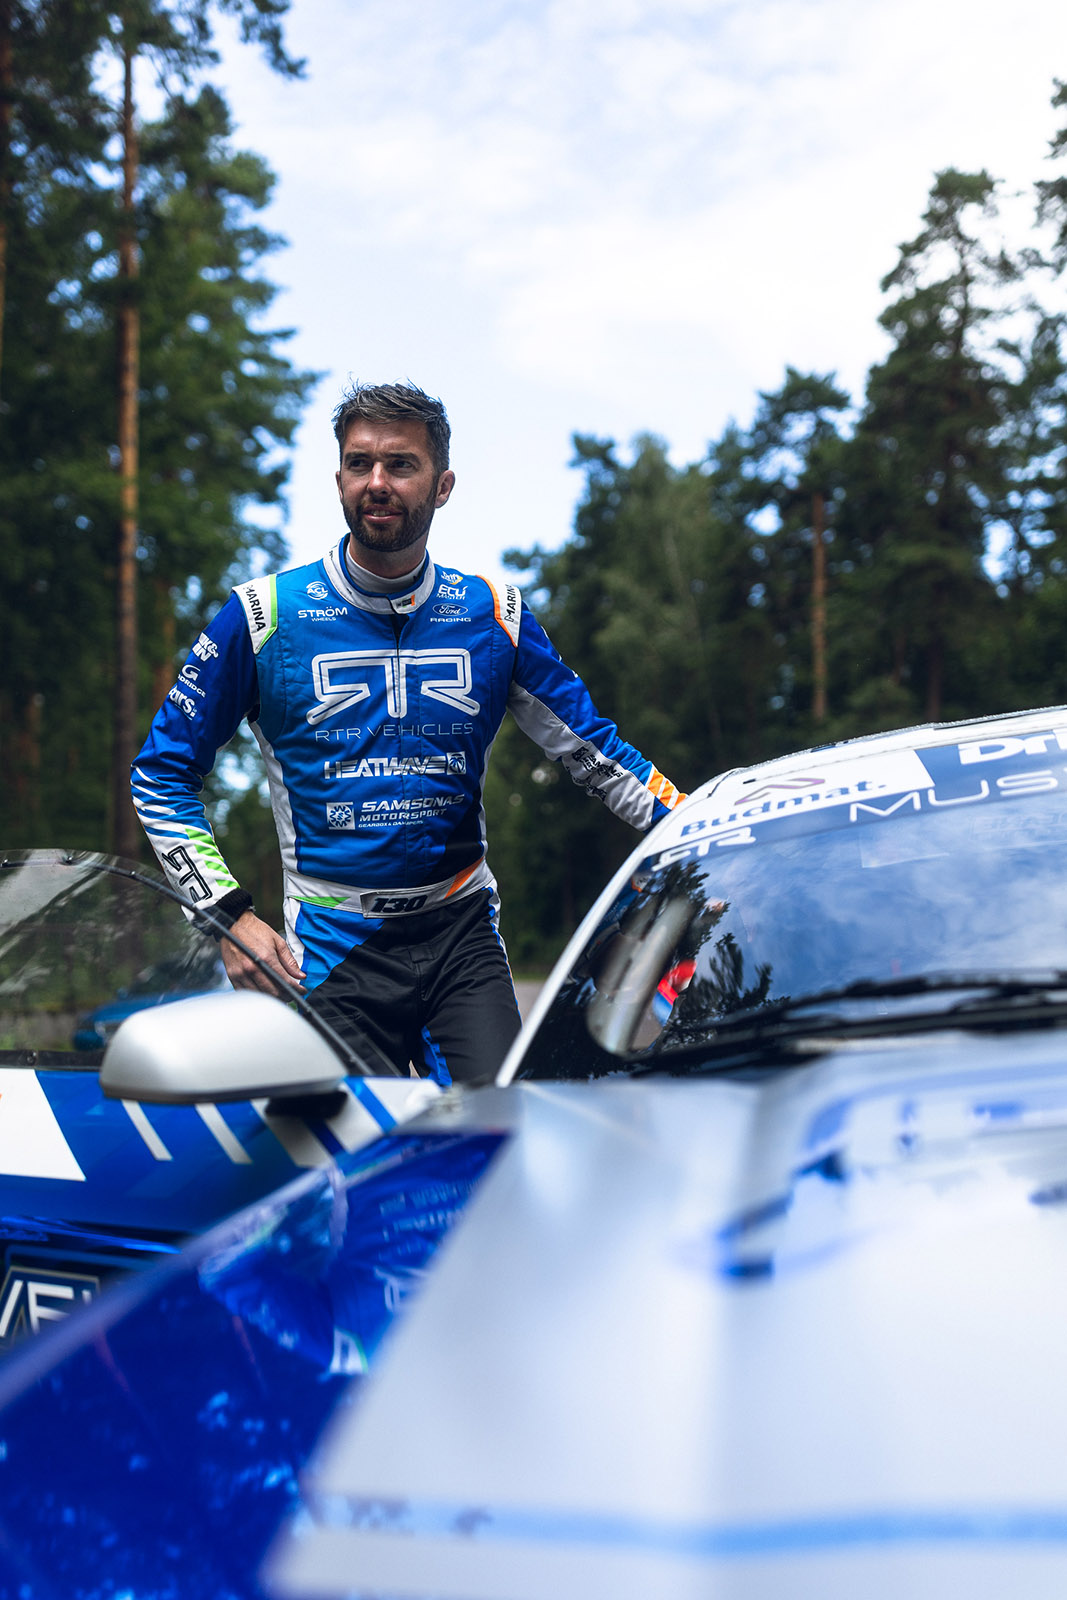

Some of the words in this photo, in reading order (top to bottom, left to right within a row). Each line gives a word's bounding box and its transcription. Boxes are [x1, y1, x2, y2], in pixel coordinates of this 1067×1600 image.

[306, 586, 328, 594] ACL
[297, 606, 348, 619] STRÖM
[438, 605, 461, 614] Ford
[504, 584, 517, 622] MARIN
[315, 727, 361, 742] RTR
[366, 722, 474, 737] VEHICLES
[324, 755, 447, 779] HEATWAVE
[361, 793, 465, 813] SAMSONAS
[848, 768, 1067, 823] MUS
[359, 808, 447, 822] MOTORSPORT
[369, 895, 428, 913] 130
